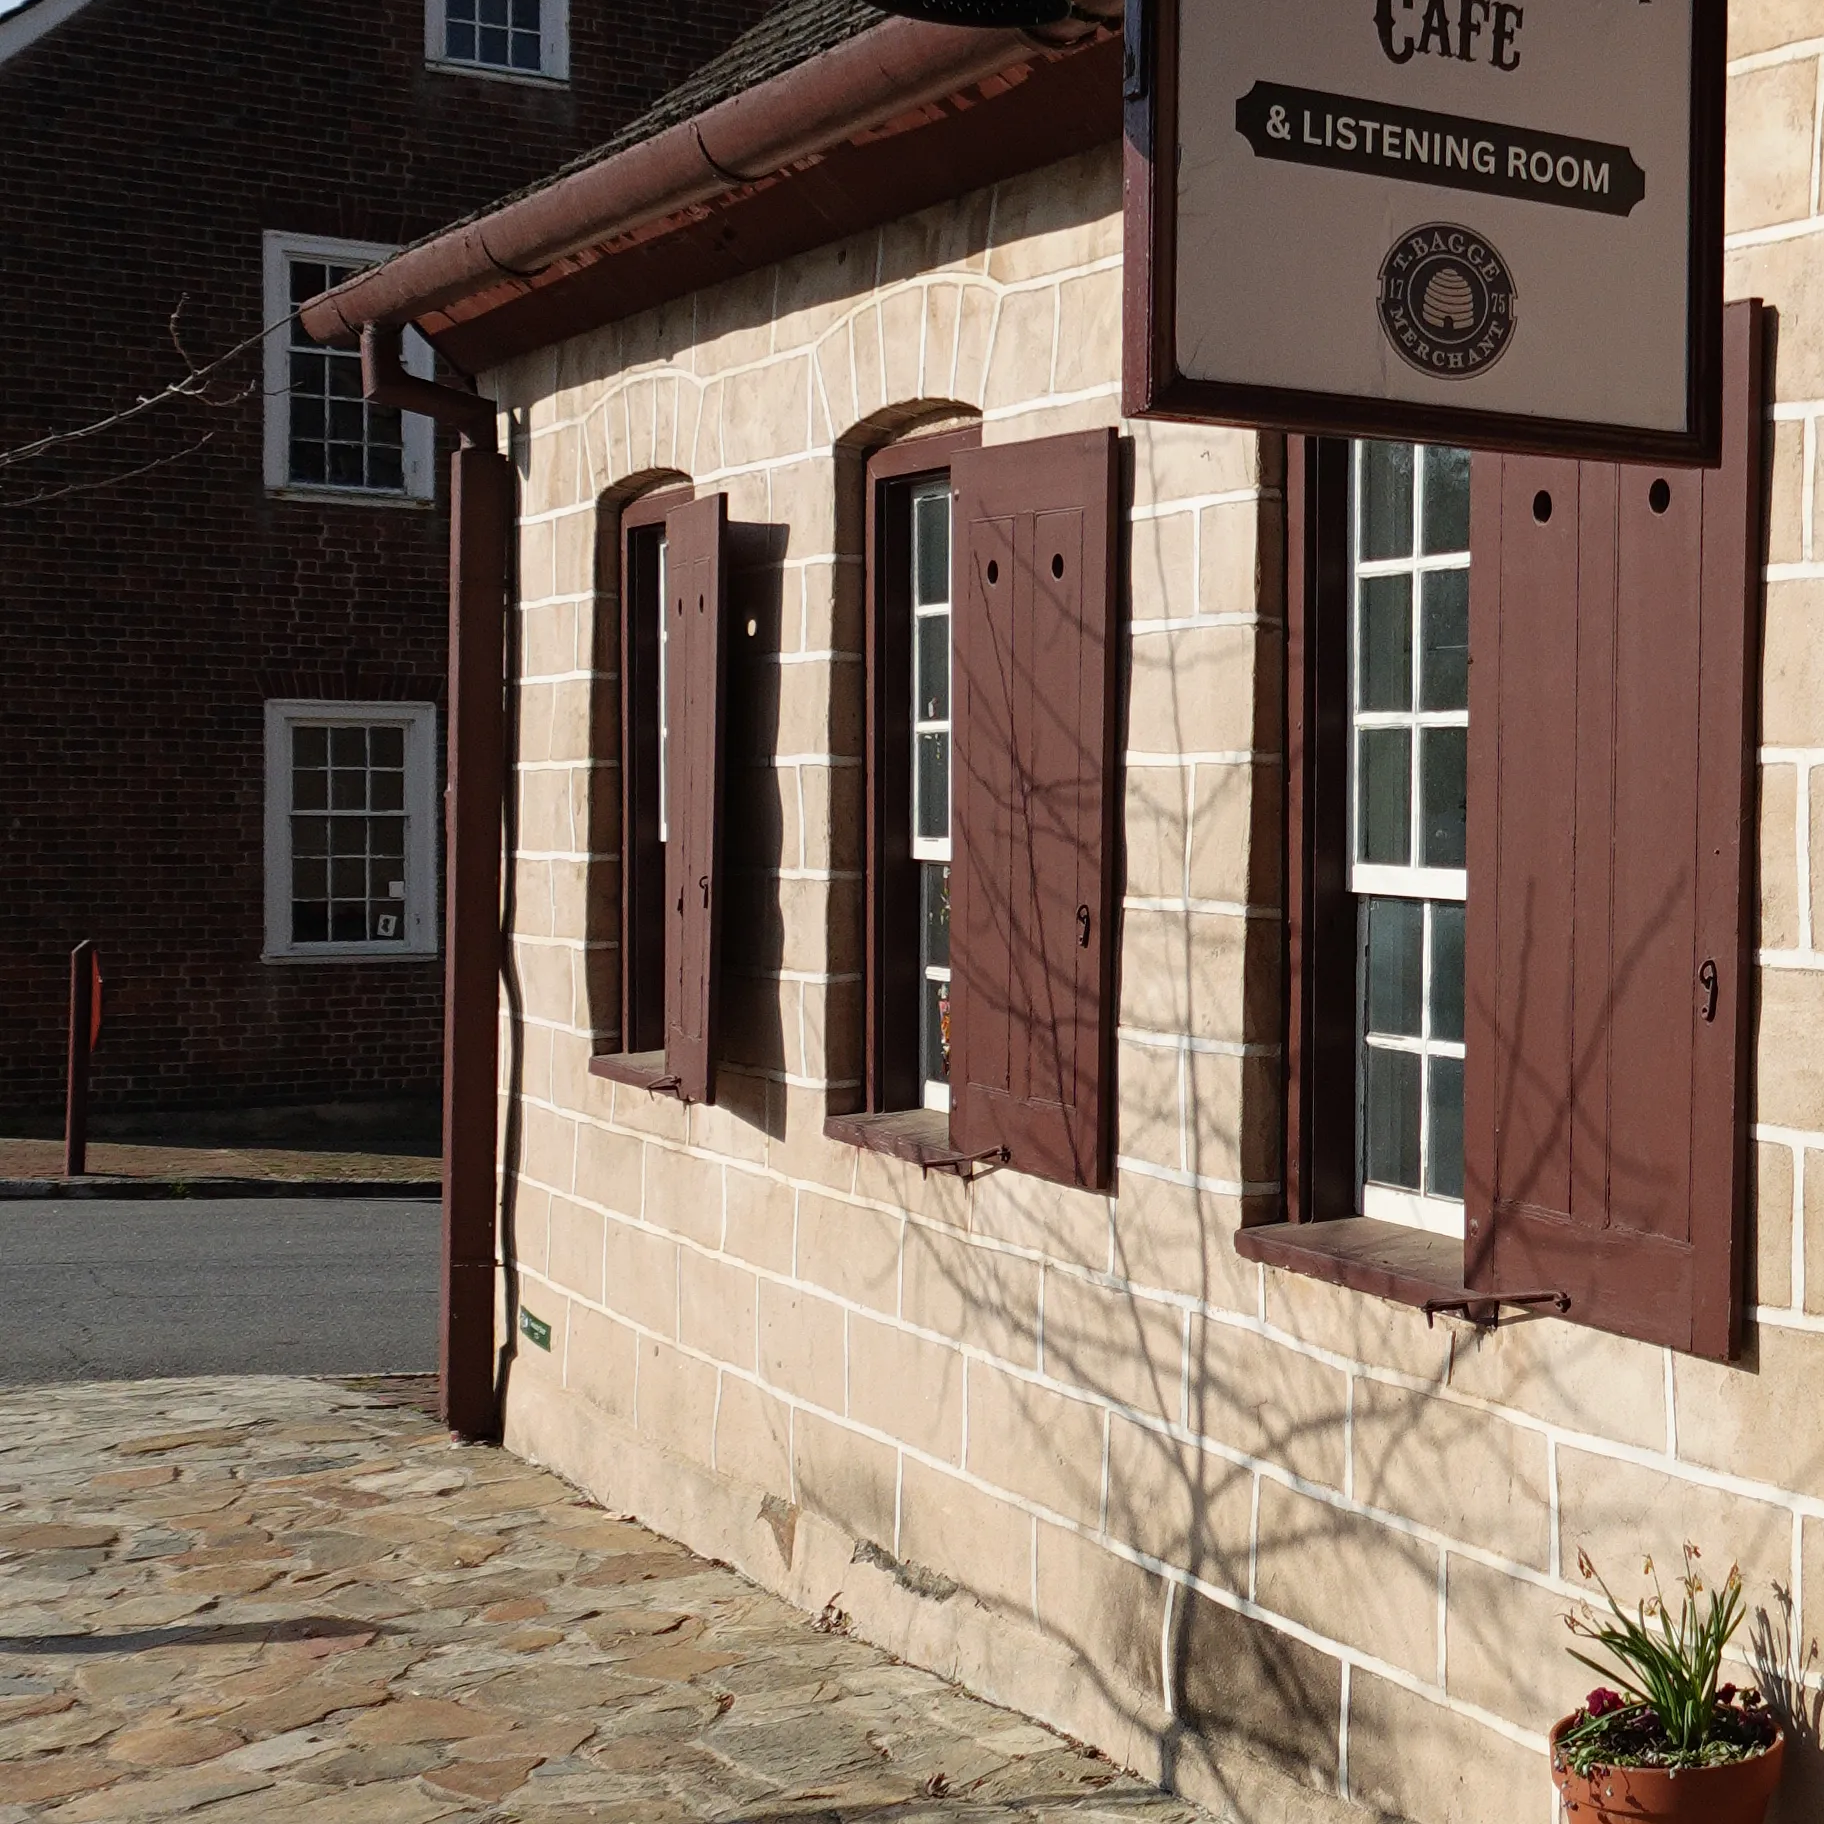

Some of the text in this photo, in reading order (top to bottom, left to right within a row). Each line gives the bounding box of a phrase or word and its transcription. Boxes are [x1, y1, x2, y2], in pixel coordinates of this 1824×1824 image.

[1265, 104, 1610, 194] & LISTENING ROOM
[1390, 278, 1506, 314] 17 75
[1390, 306, 1505, 369] MERCHANT
